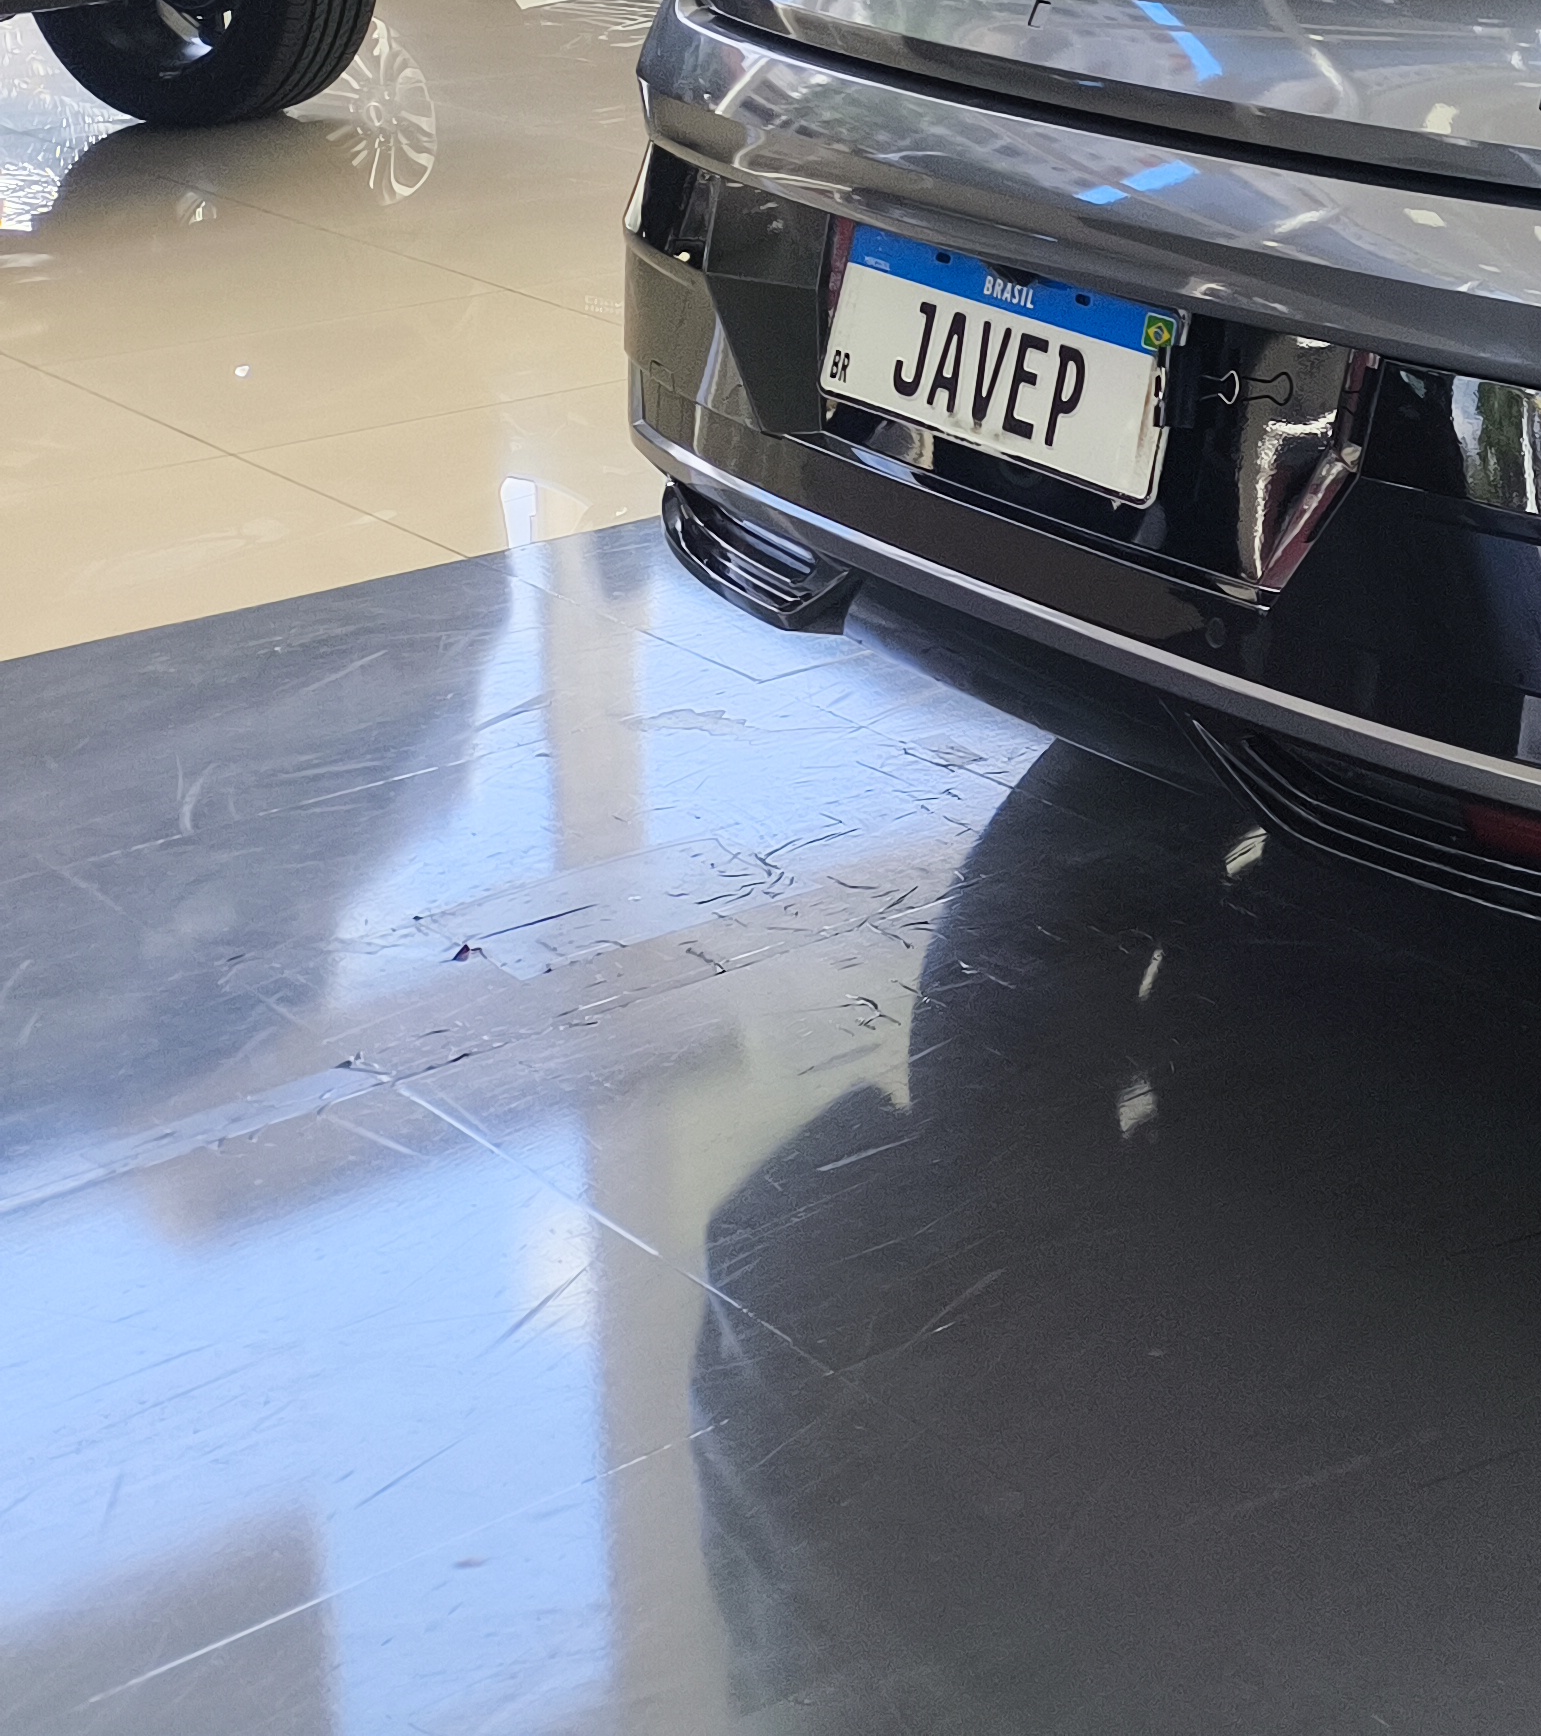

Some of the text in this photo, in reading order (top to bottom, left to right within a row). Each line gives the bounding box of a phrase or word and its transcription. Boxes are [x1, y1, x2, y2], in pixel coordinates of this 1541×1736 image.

[983, 275, 1034, 309] BRASIL
[831, 349, 850, 383] BR
[892, 301, 1086, 447] JAVEP
